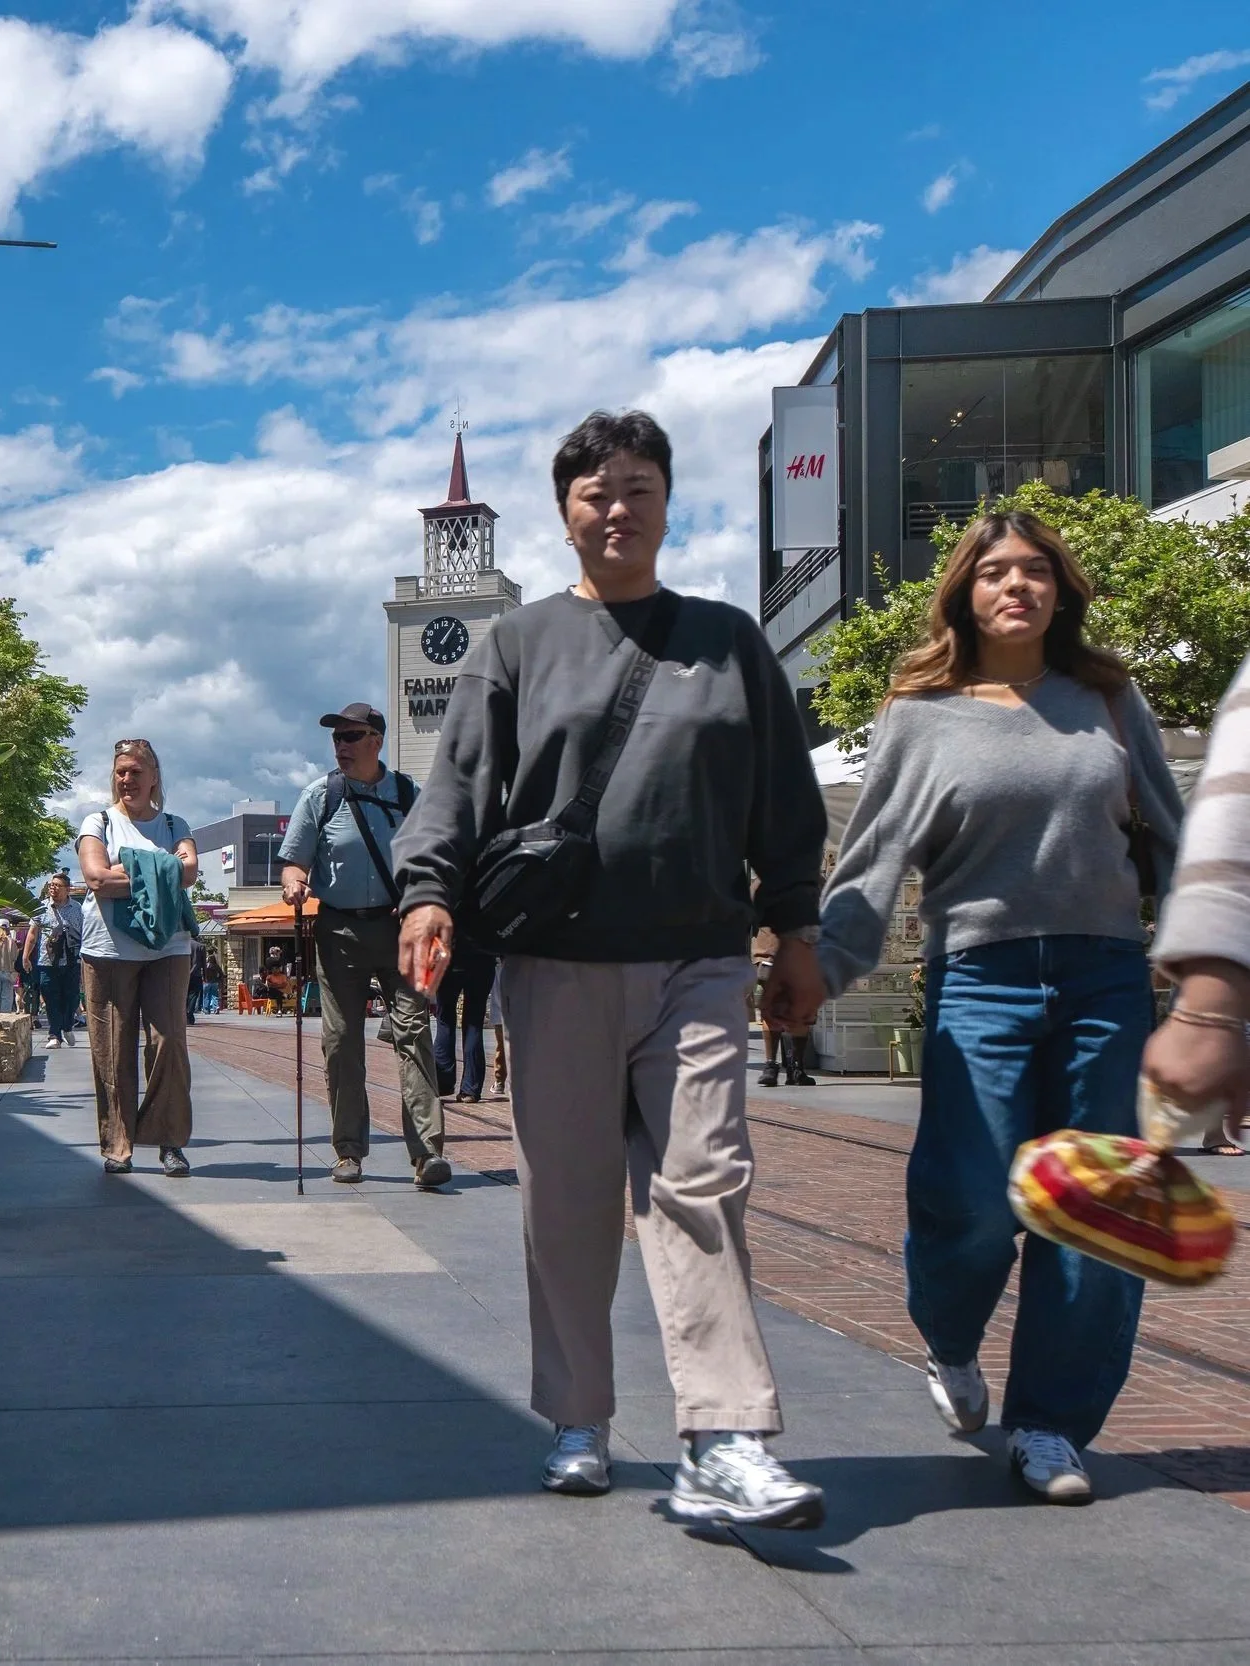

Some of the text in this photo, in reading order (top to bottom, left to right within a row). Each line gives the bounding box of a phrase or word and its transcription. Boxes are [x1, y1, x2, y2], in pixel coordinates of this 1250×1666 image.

[786, 454, 825, 479] H&M
[427, 646, 433, 654] 8
[434, 652, 440, 660] 7
[451, 651, 456, 659] 5
[606, 651, 657, 747] SUPRE
[408, 698, 450, 717] MAR
